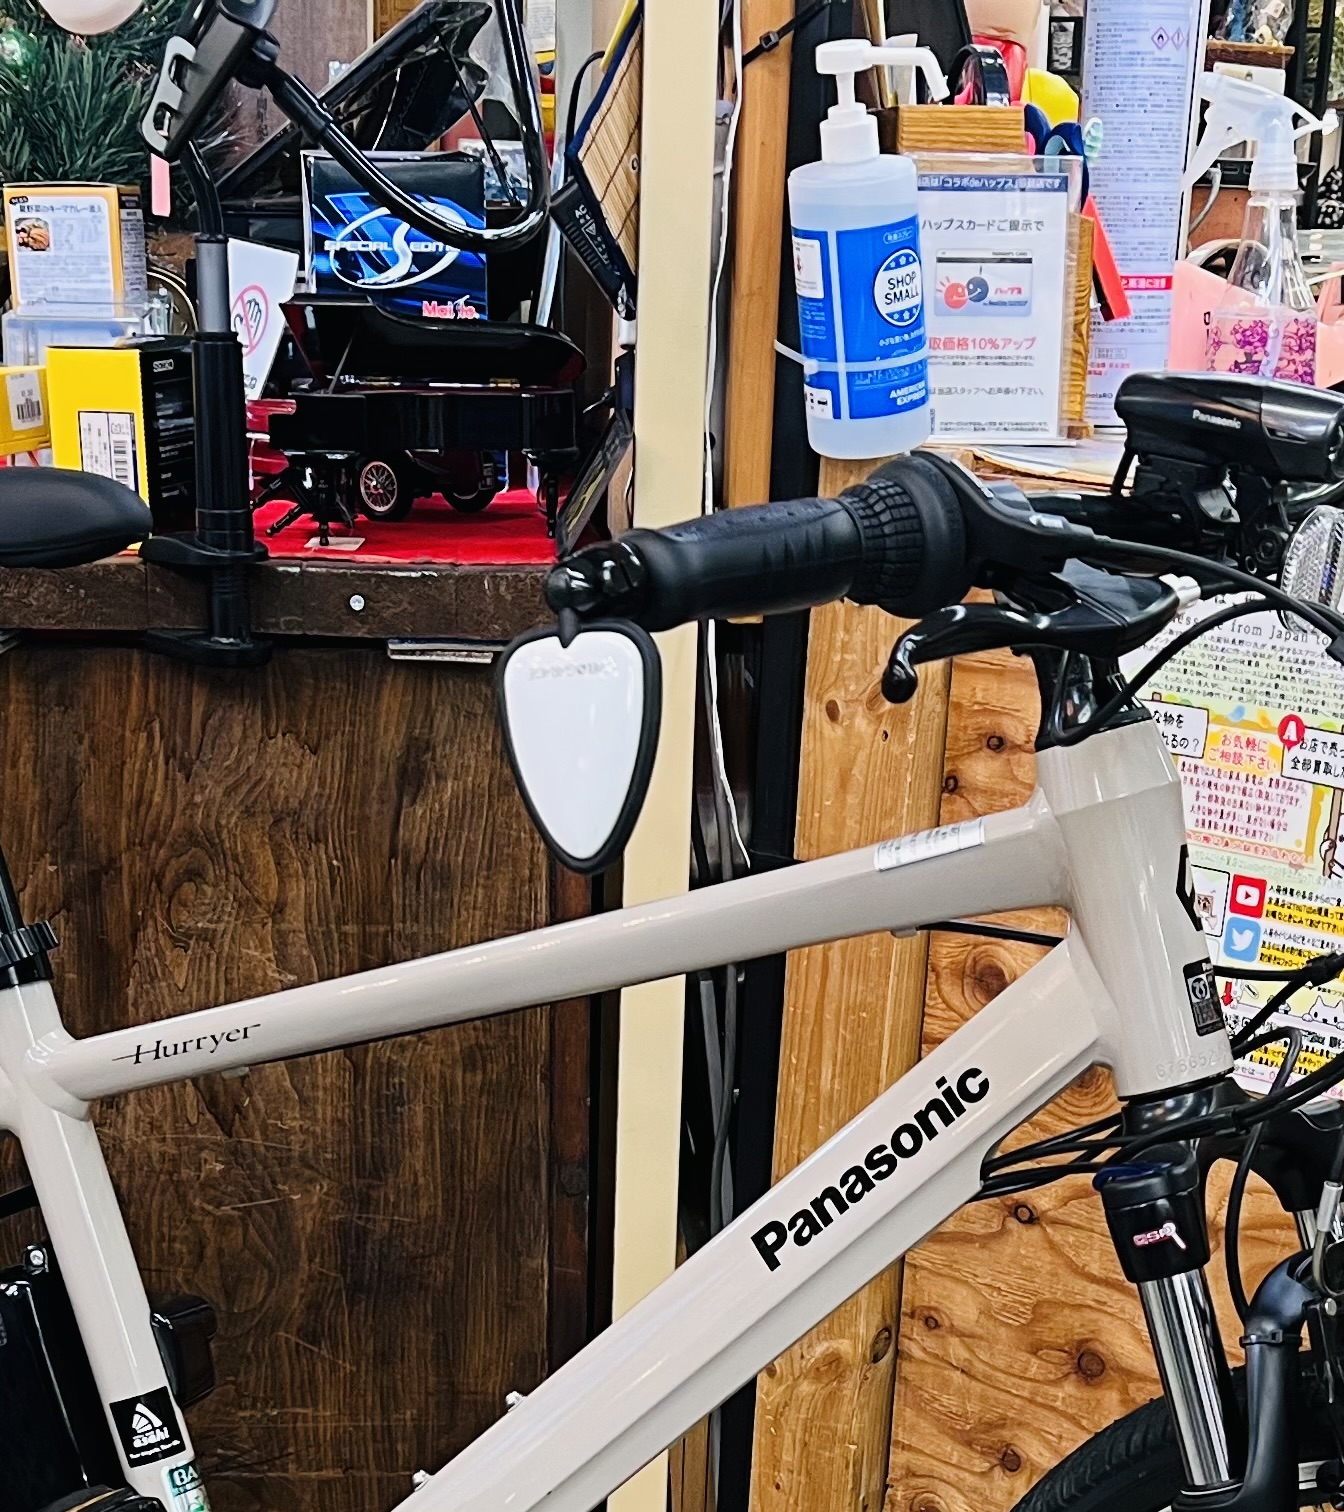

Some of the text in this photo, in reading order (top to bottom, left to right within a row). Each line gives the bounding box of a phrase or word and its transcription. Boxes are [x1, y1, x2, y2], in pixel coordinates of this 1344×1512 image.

[324, 240, 393, 251] SPECIAL
[887, 270, 917, 290] SHOP
[884, 289, 920, 306] SMALL
[1192, 408, 1243, 429] Panasonic
[1230, 618, 1263, 637] from
[1268, 624, 1310, 646] Japan
[1221, 733, 1269, 752] お気軽に
[1209, 747, 1278, 772] ご相談下さい
[112, 1023, 261, 1065] Hurryer
[750, 1067, 990, 1272] Panasonic
